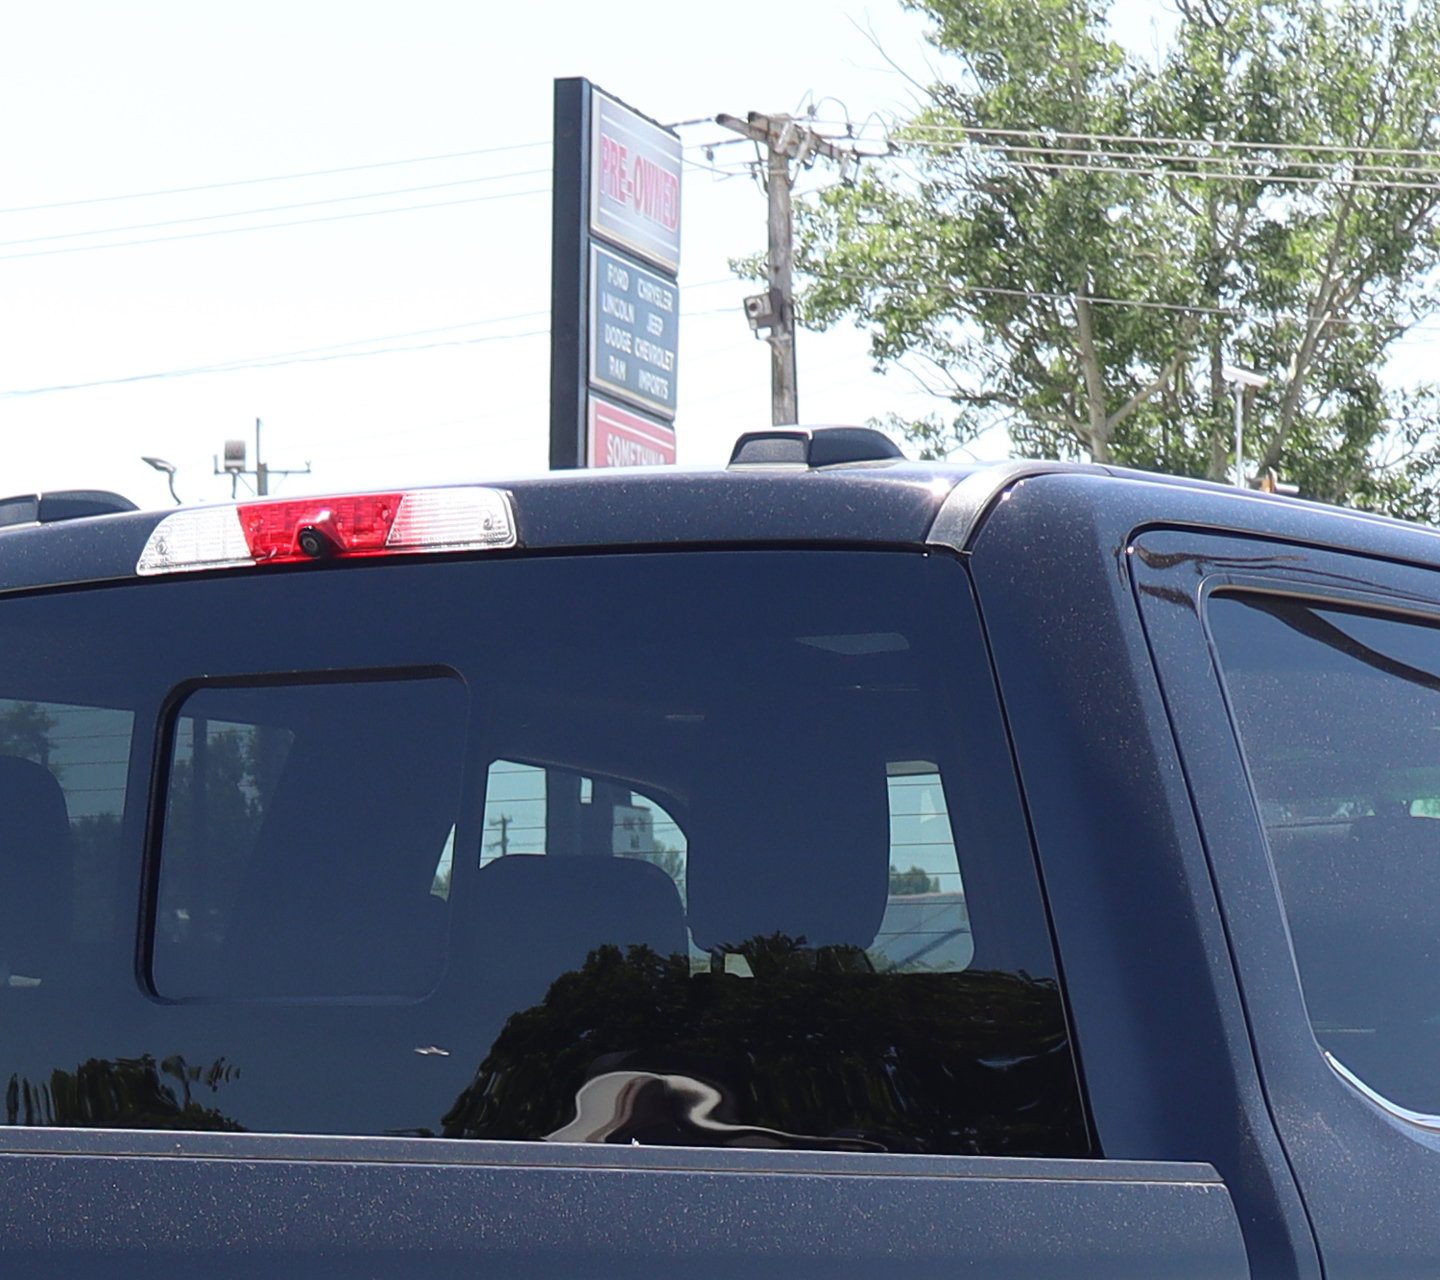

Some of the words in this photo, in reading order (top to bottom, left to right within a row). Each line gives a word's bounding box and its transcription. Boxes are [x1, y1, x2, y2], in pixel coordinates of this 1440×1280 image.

[599, 135, 679, 232] PRE-OWNED
[607, 263, 629, 291] FORD
[637, 278, 674, 312] CHRYSLER
[602, 291, 634, 323] LINCOLN
[646, 312, 663, 337] JEEP
[605, 323, 632, 354] DODGE
[635, 337, 674, 372] CHEVROLET
[609, 355, 627, 381] RAM
[638, 369, 669, 400] IMPORTS
